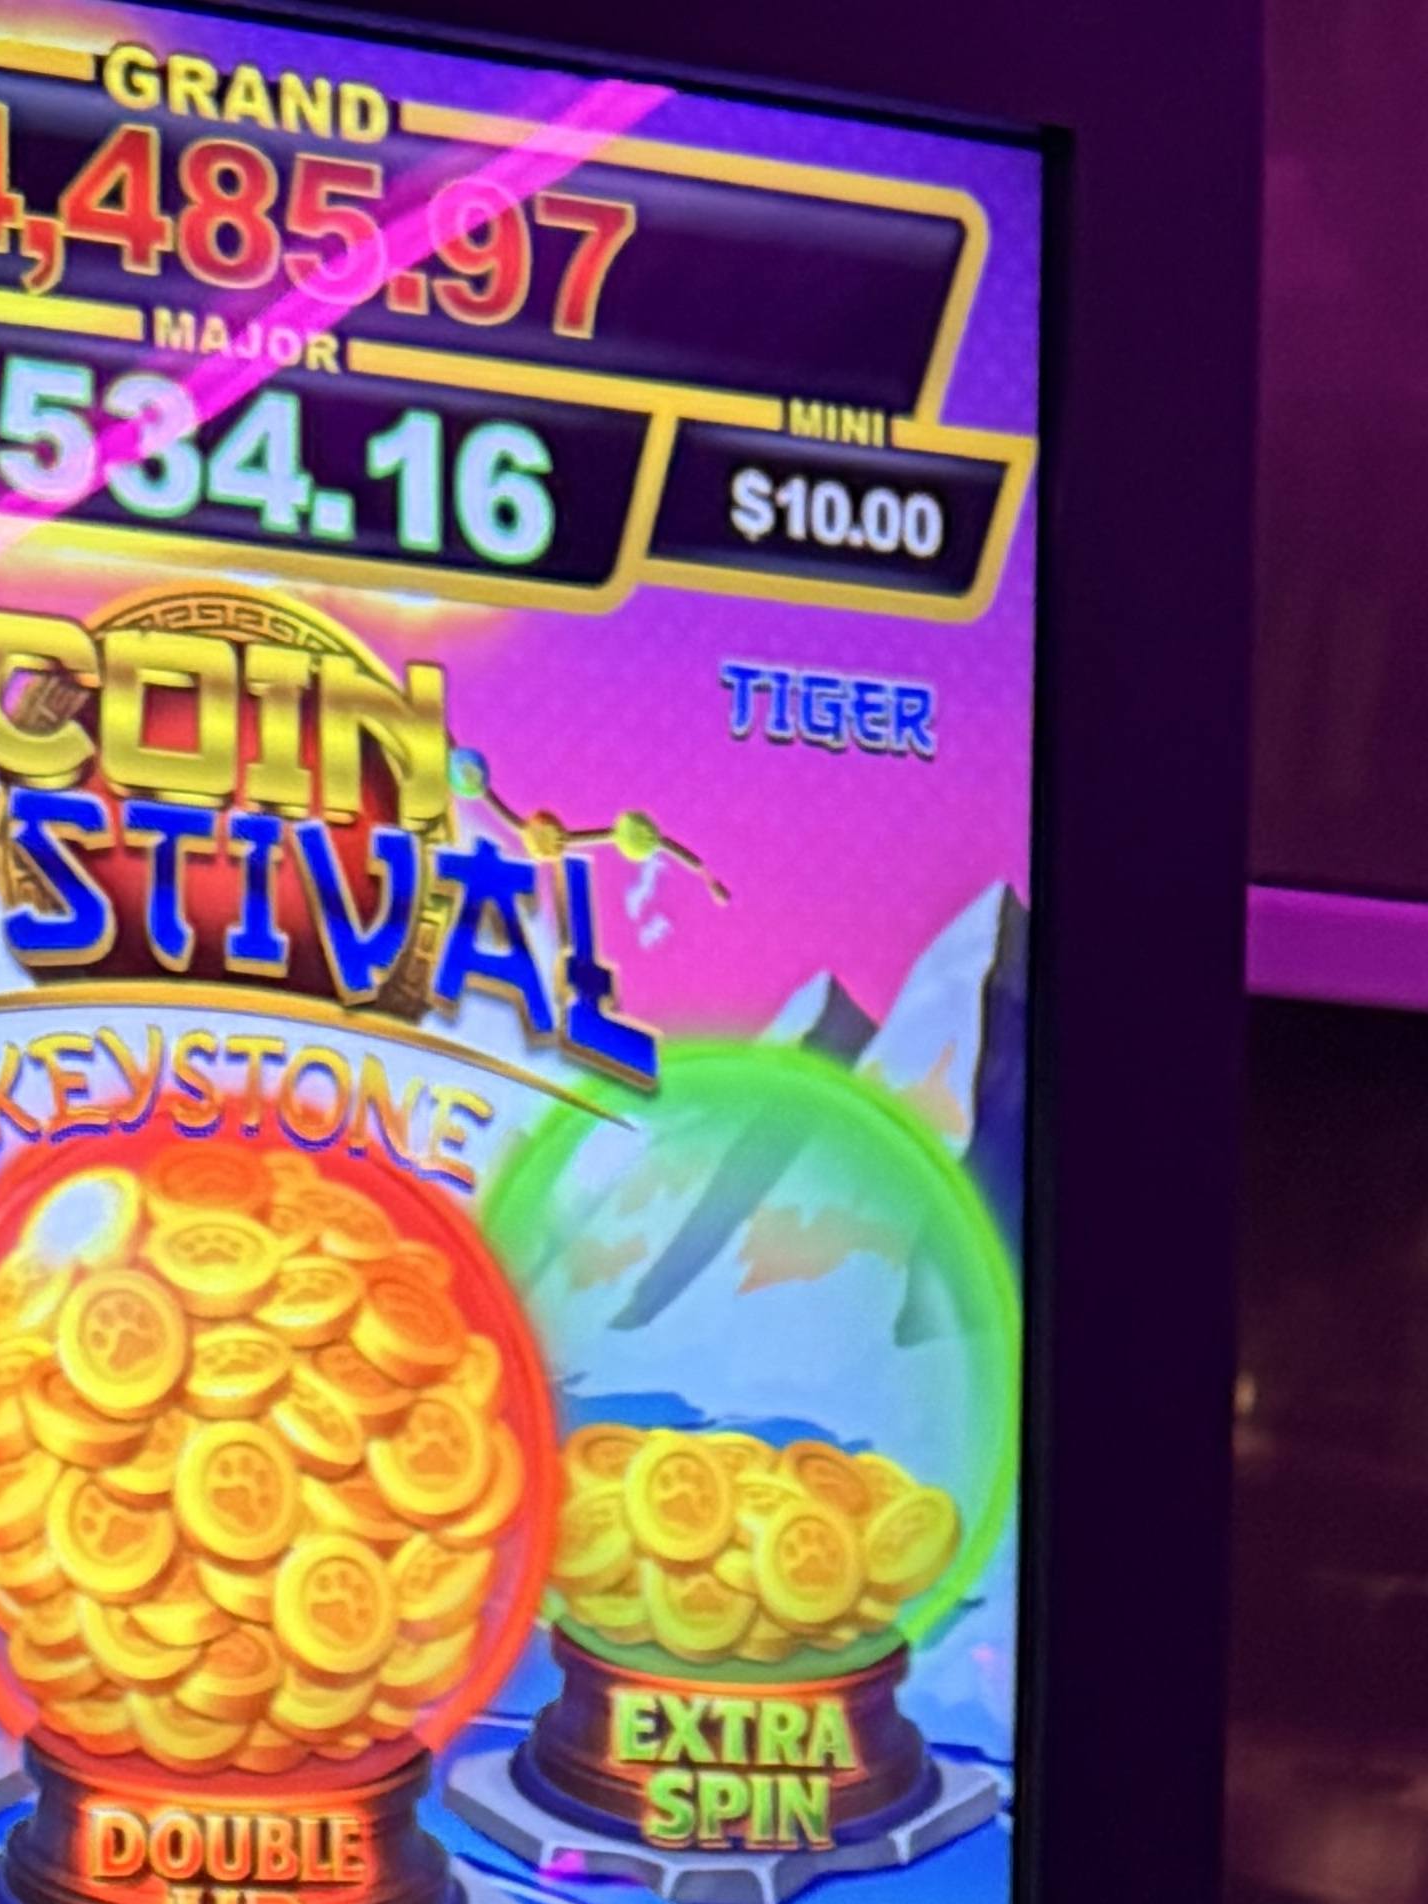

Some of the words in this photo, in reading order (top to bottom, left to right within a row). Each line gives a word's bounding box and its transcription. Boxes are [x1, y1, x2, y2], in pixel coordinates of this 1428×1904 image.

[103, 44, 389, 143] GRAND
[152, 308, 342, 373] MAJOR
[788, 399, 888, 448] MINI
[730, 468, 944, 558] $10.00
[721, 660, 937, 758] TIGER
[612, 1688, 858, 1772] EXTRA
[89, 1806, 368, 1885] DOUBLE
[644, 1768, 835, 1850] SPIN
